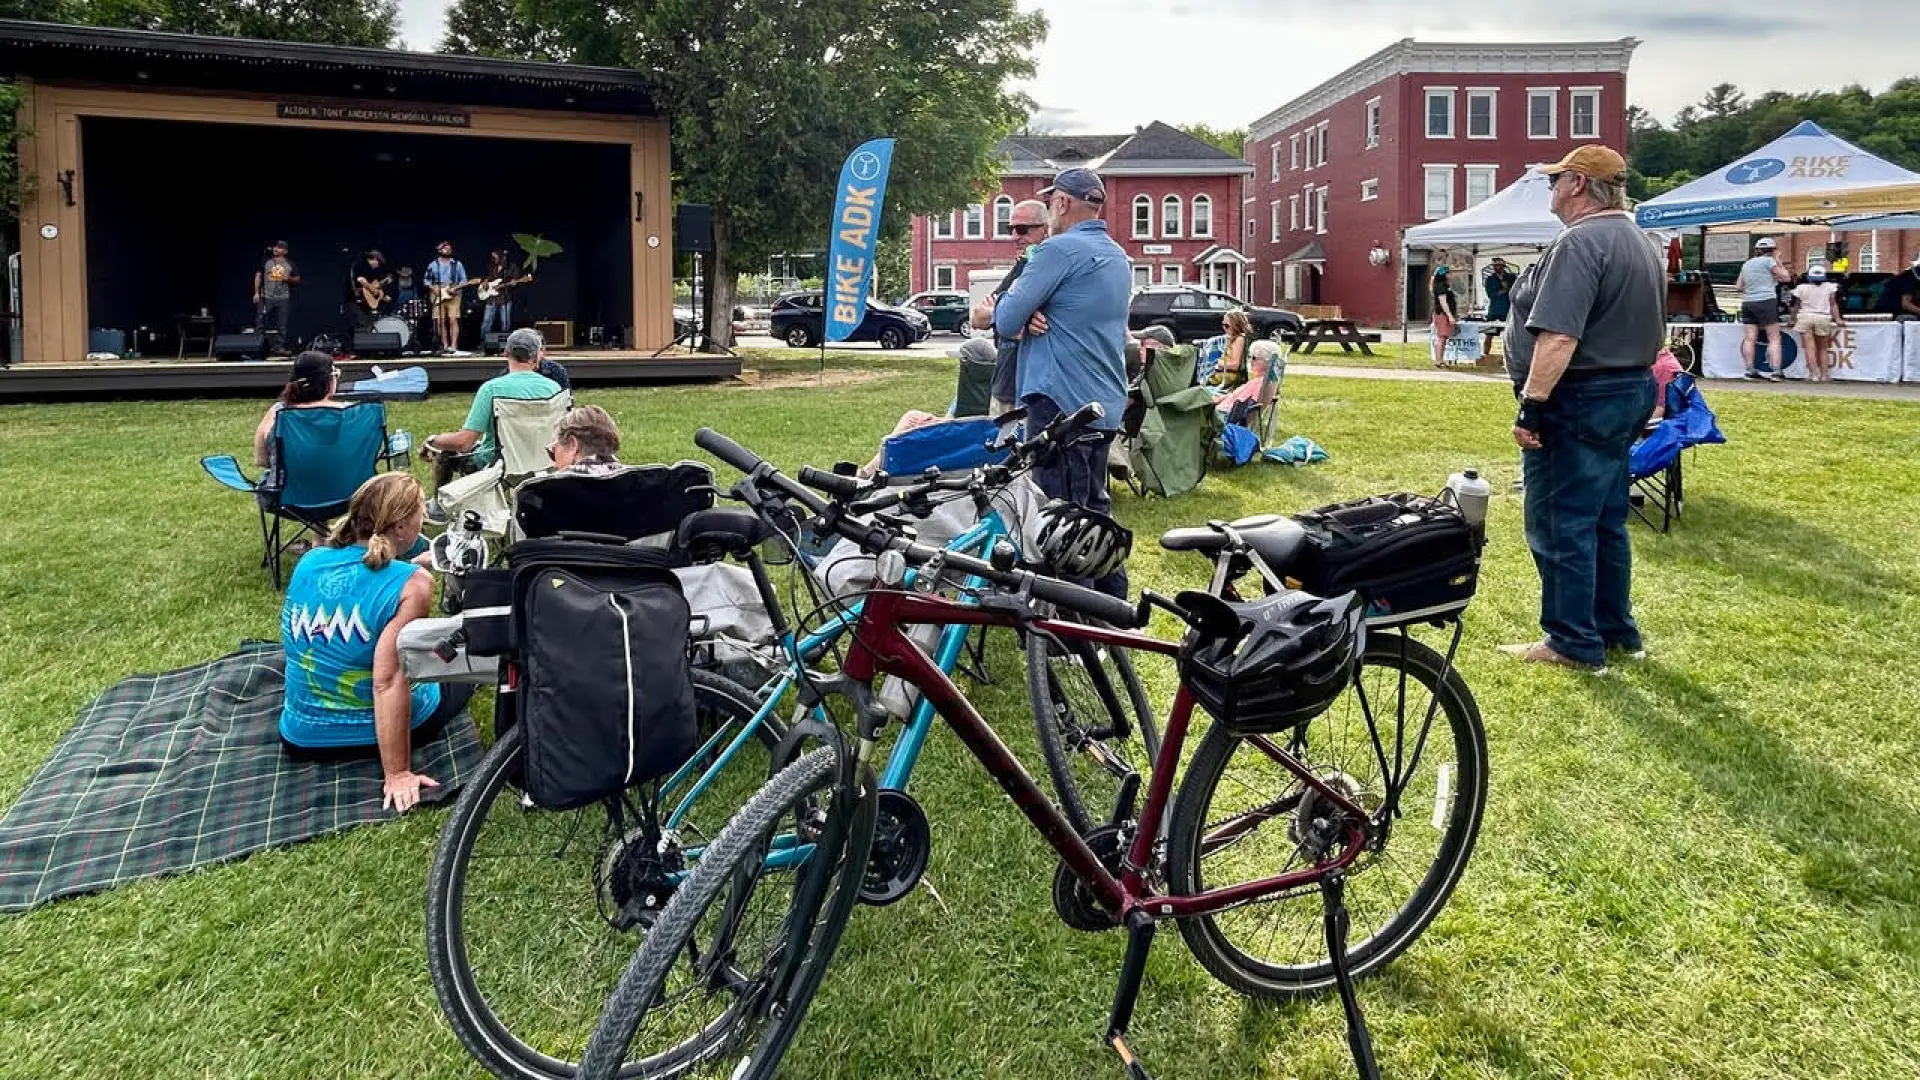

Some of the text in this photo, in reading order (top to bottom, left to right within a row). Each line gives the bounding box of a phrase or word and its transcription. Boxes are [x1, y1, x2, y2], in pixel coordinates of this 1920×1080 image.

[1790, 156, 1850, 167] BIKE
[1788, 167, 1846, 177] ADK
[833, 185, 876, 324] BIKE ADK
